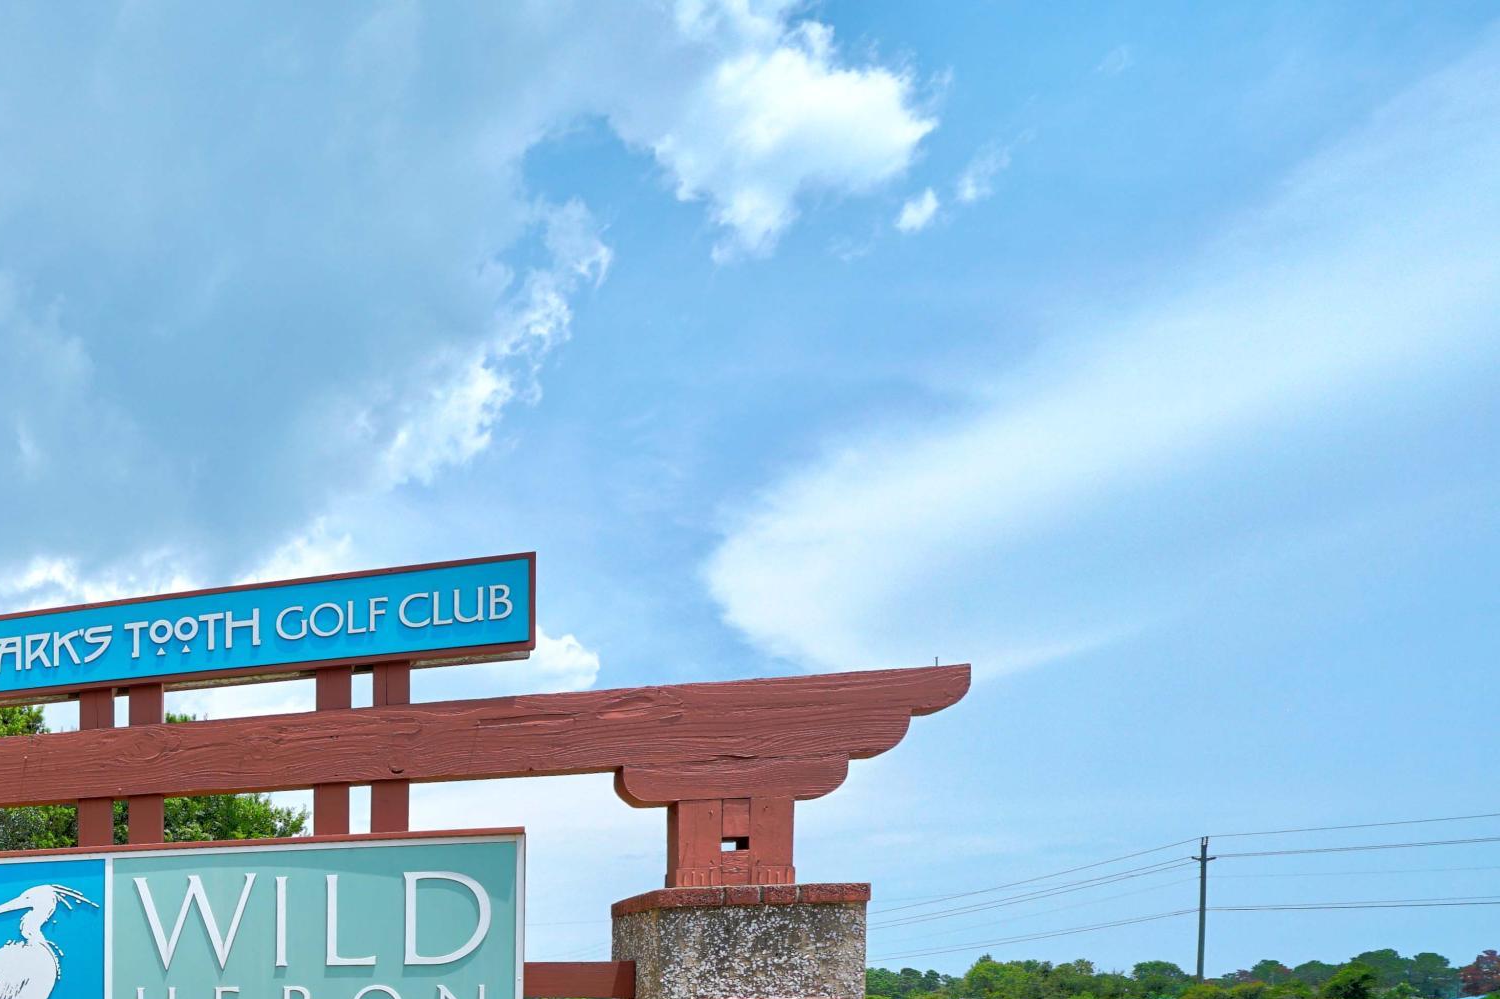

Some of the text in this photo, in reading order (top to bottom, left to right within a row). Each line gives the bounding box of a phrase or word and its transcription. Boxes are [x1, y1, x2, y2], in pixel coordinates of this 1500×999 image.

[125, 607, 261, 660] TOOTH
[275, 596, 388, 640] GOLF
[398, 584, 513, 629] CLUB
[133, 870, 492, 971] WILD
